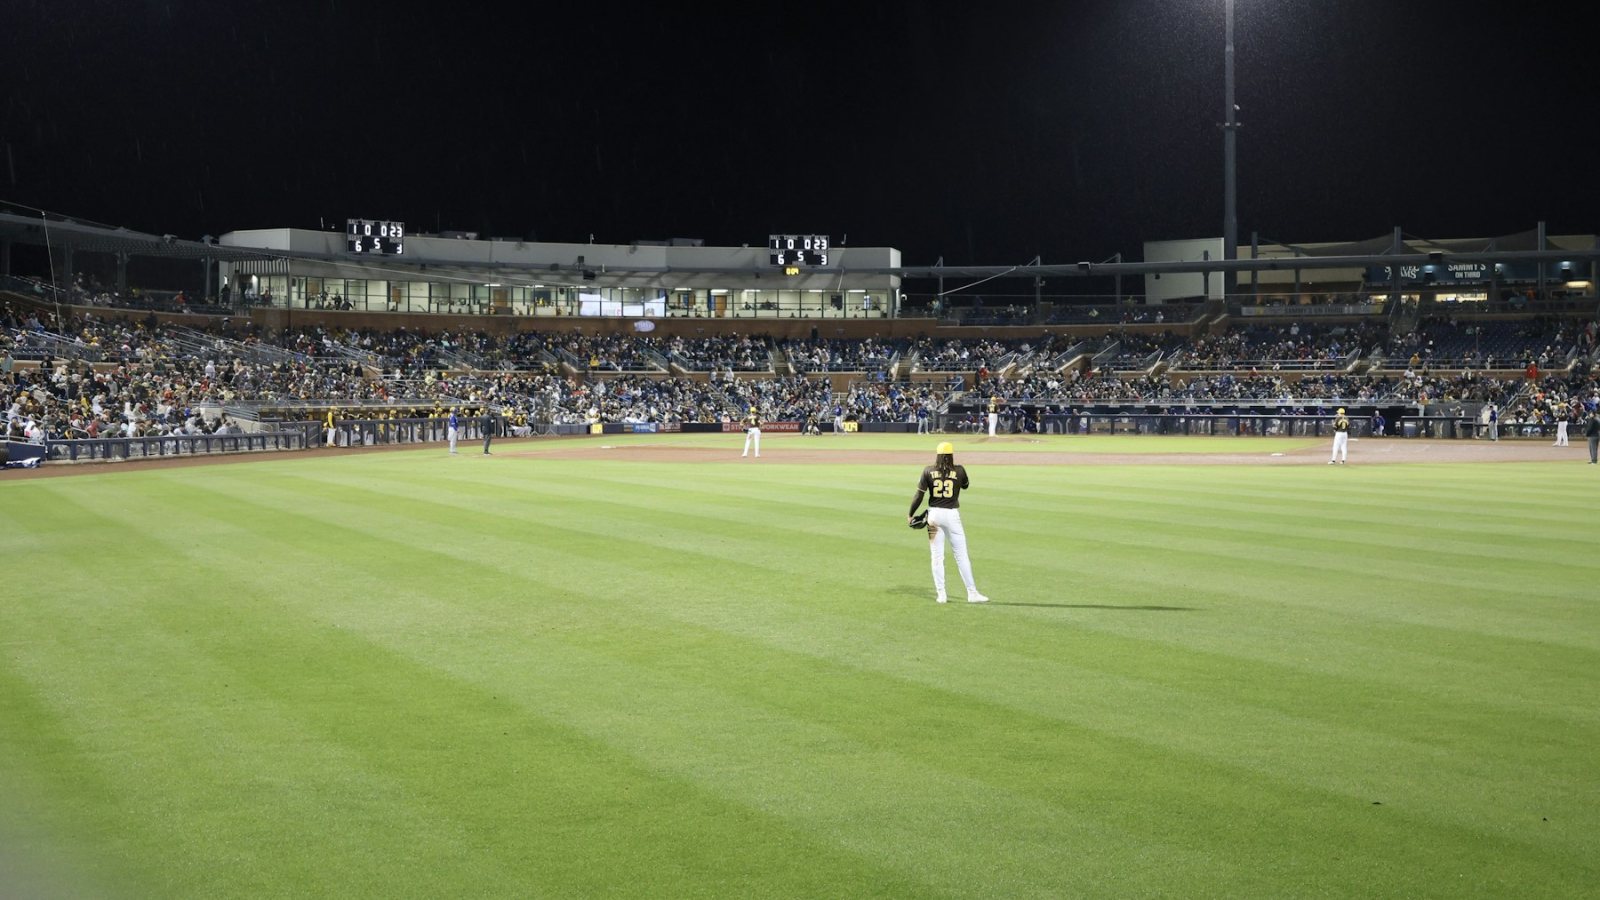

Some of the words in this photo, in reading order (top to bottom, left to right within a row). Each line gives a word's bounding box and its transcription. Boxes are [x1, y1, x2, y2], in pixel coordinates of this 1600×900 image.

[354, 224, 357, 234] 1
[365, 224, 371, 236] 0
[381, 225, 387, 237] 0
[390, 226, 402, 238] 23
[356, 240, 362, 252] 6
[374, 238, 380, 250] 5
[776, 240, 779, 249] 1
[788, 239, 794, 250] 0
[804, 239, 811, 250] 0
[814, 239, 827, 250] 23
[778, 254, 784, 265] 6
[797, 251, 804, 261] 5
[821, 254, 827, 265] 3
[933, 479, 953, 498] 23
